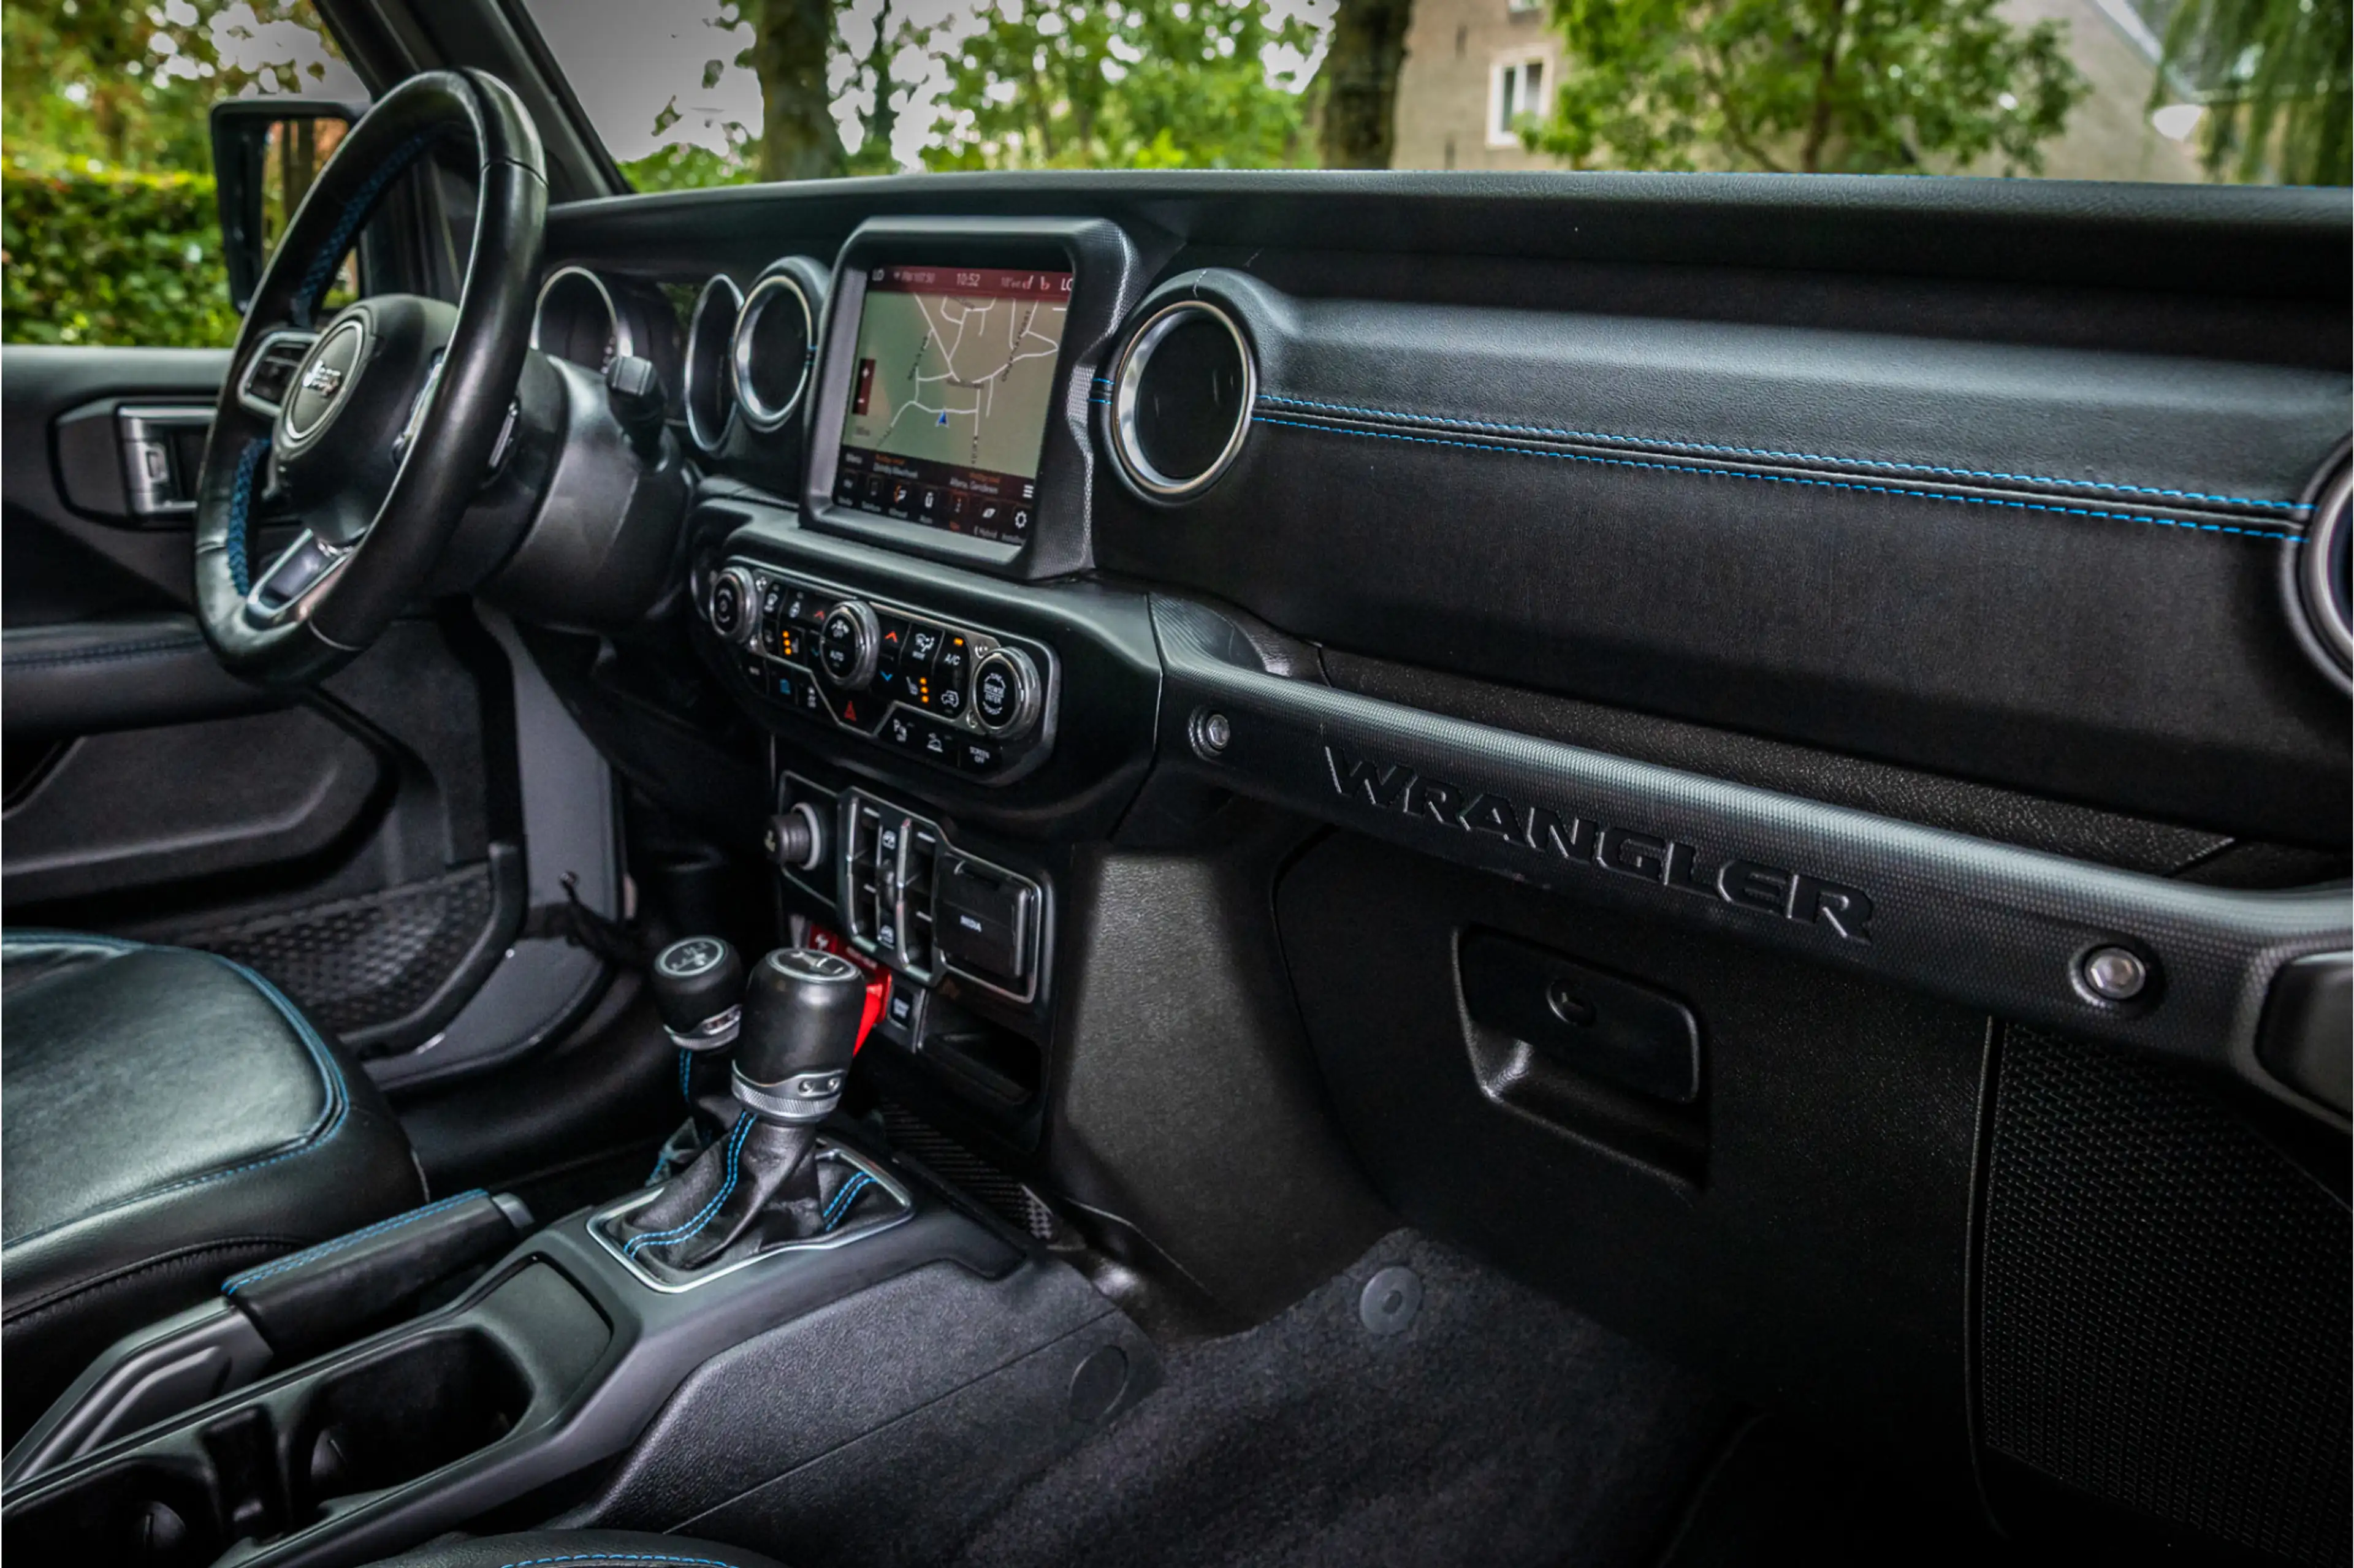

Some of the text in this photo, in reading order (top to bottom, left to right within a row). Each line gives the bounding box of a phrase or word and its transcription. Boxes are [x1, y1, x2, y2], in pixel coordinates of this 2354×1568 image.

[956, 273, 980, 286] 10:52
[944, 653, 961, 666] A/C
[1325, 745, 1875, 945] WRANGLER
